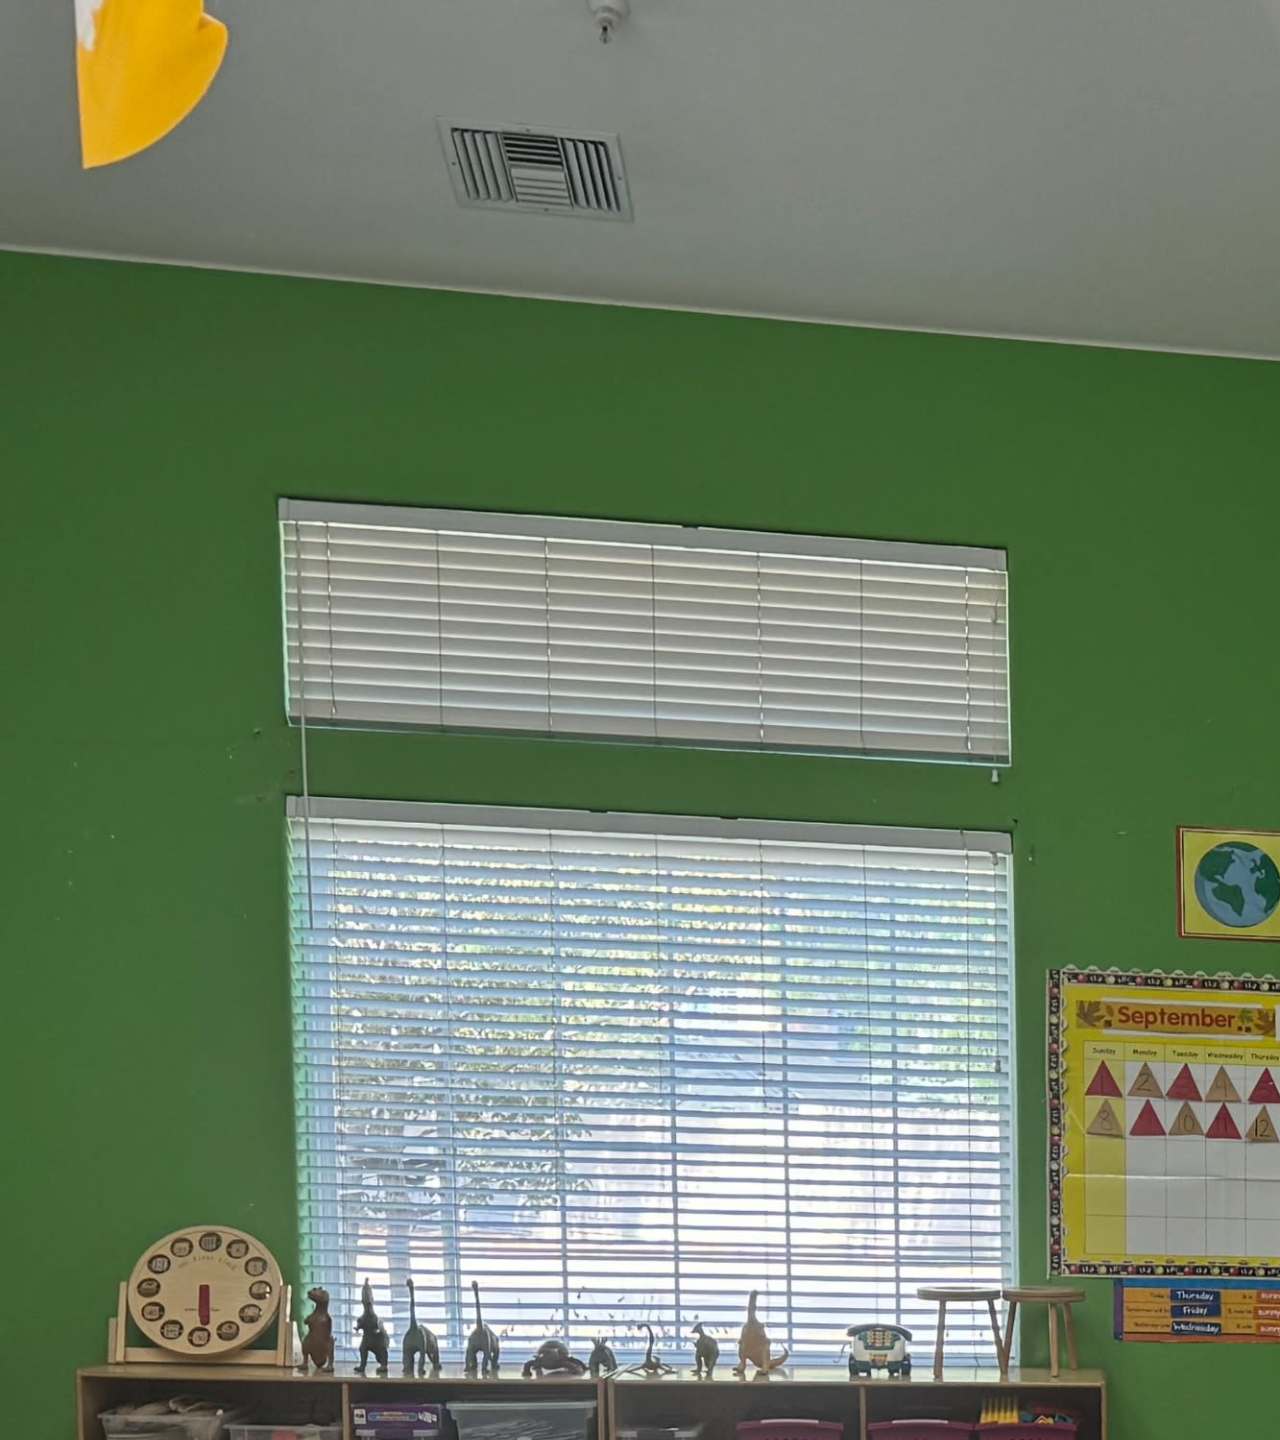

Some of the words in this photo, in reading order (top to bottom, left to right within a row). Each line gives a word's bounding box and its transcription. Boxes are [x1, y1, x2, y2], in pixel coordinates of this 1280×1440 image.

[1117, 1006, 1236, 1029] September
[1254, 1117, 1269, 1137] 12
[1176, 1290, 1215, 1302] Thursday
[1182, 1305, 1208, 1316] Friday
[1172, 1321, 1220, 1334] Wednesday
